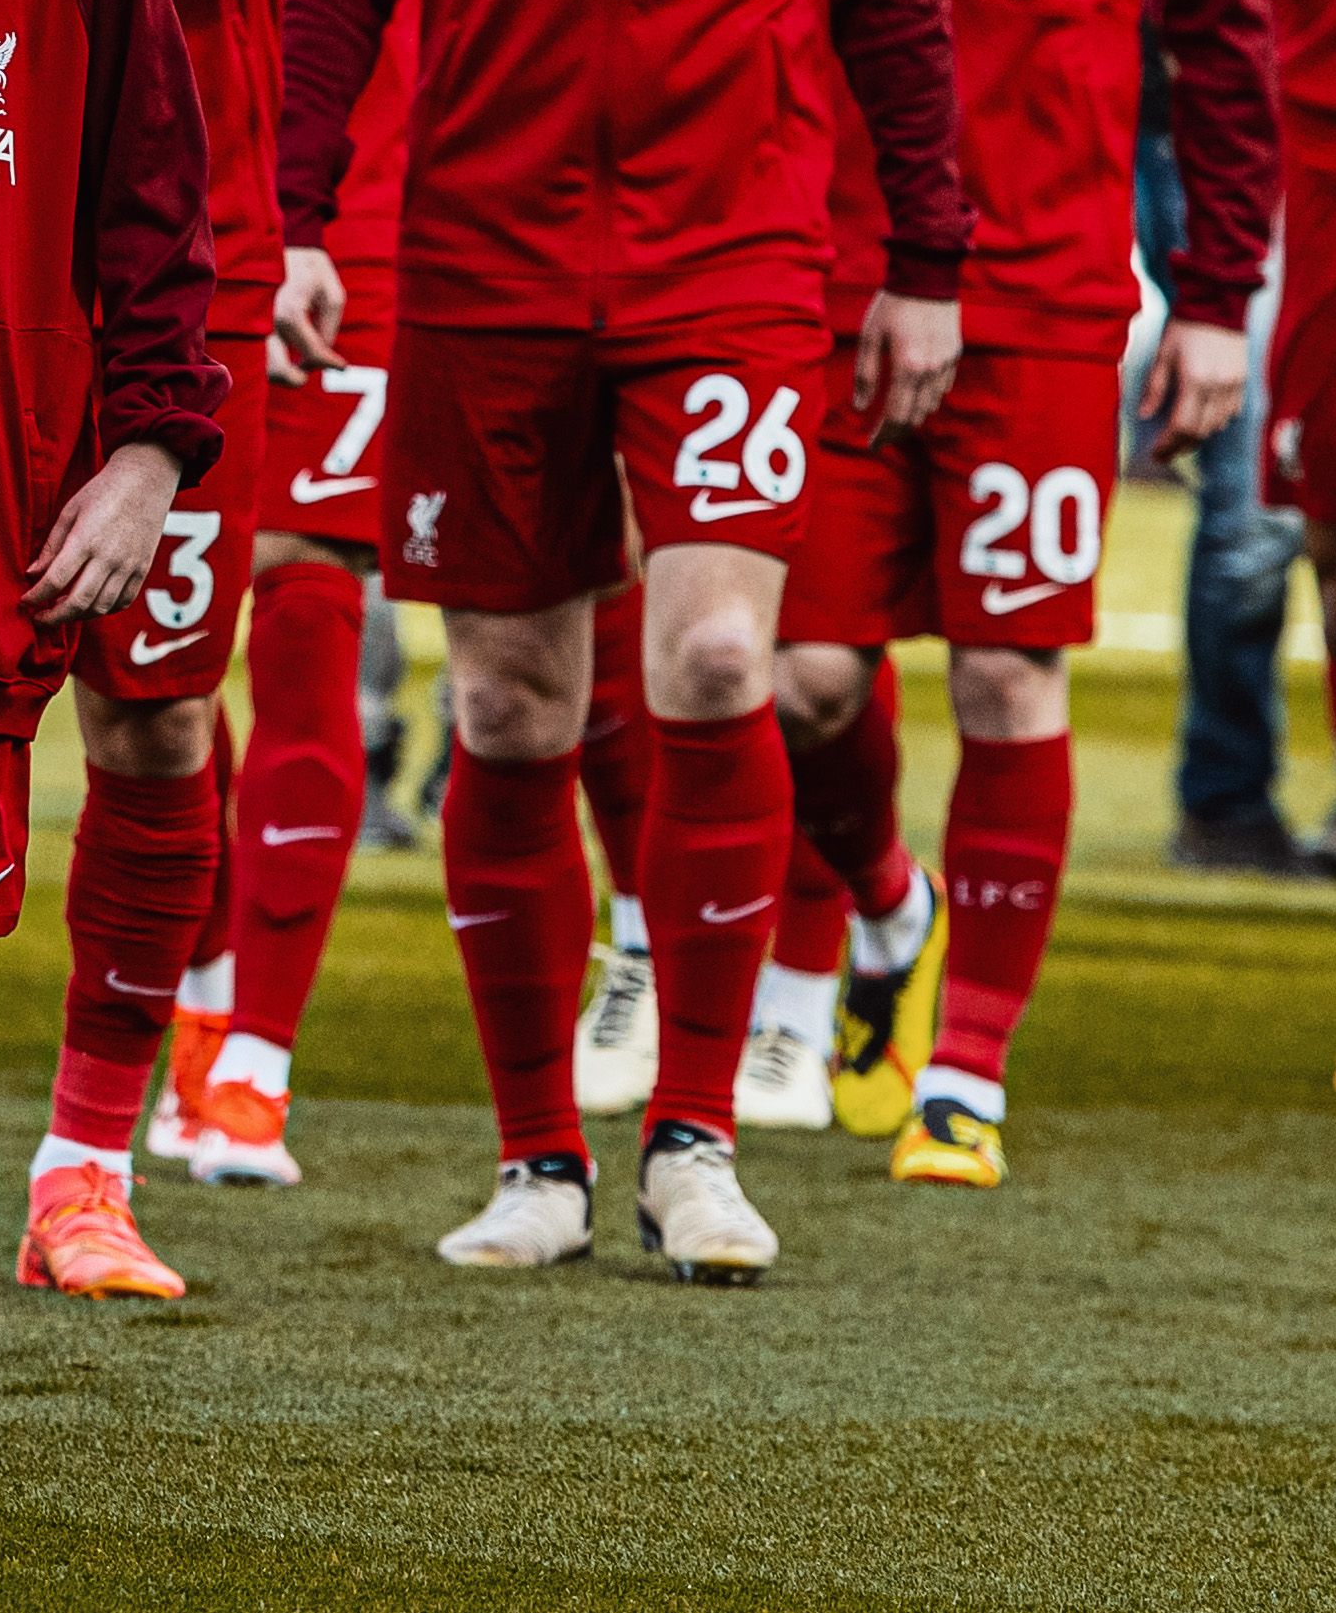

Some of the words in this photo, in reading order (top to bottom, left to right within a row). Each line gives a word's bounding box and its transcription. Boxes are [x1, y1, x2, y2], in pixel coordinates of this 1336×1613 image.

[321, 370, 388, 476] 7
[673, 373, 806, 504] 26
[144, 510, 221, 629] 3
[959, 462, 1101, 585] 20
